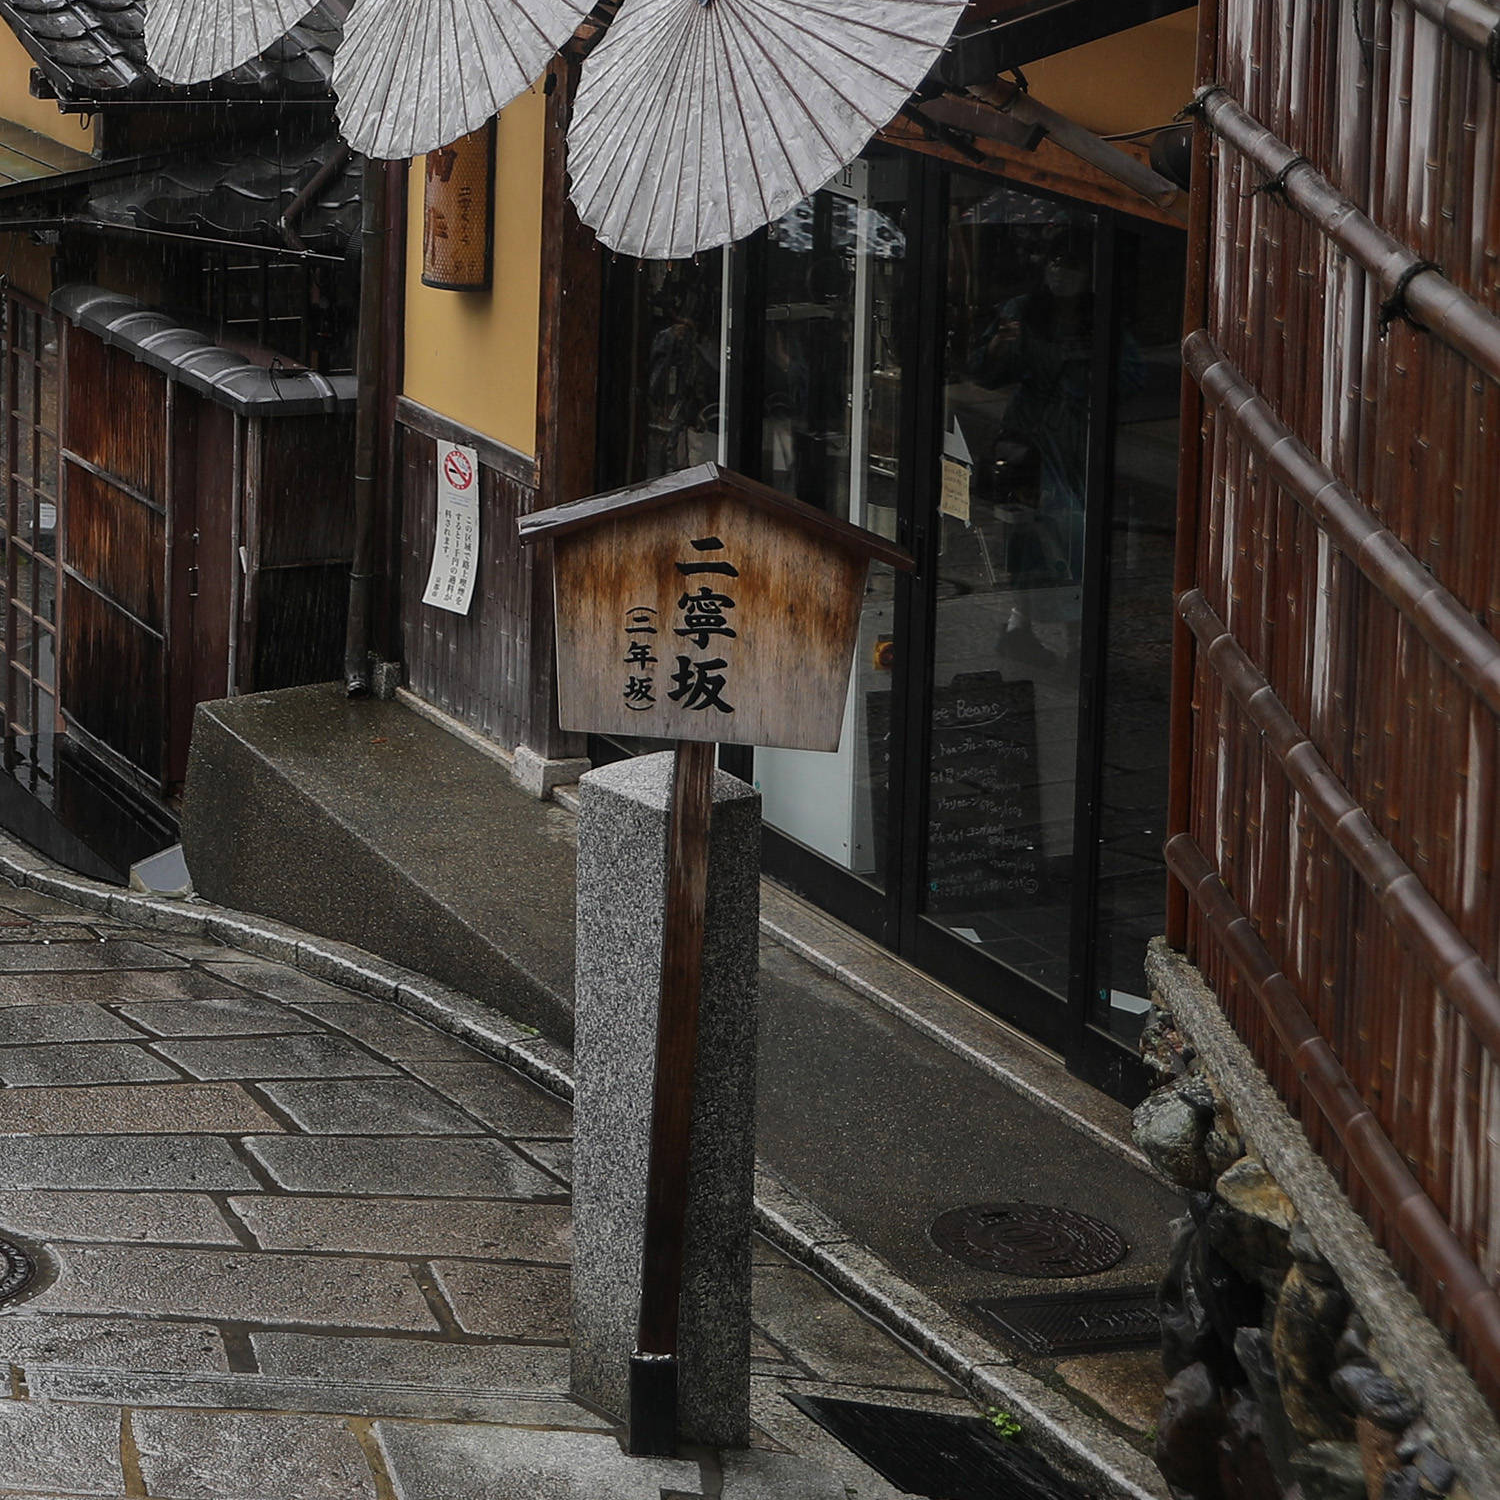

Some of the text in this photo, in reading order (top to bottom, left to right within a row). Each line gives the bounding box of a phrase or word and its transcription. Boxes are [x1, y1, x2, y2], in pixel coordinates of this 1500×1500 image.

[667, 537, 739, 713] 二寧坂
[931, 699, 1000, 722] ee Beans
